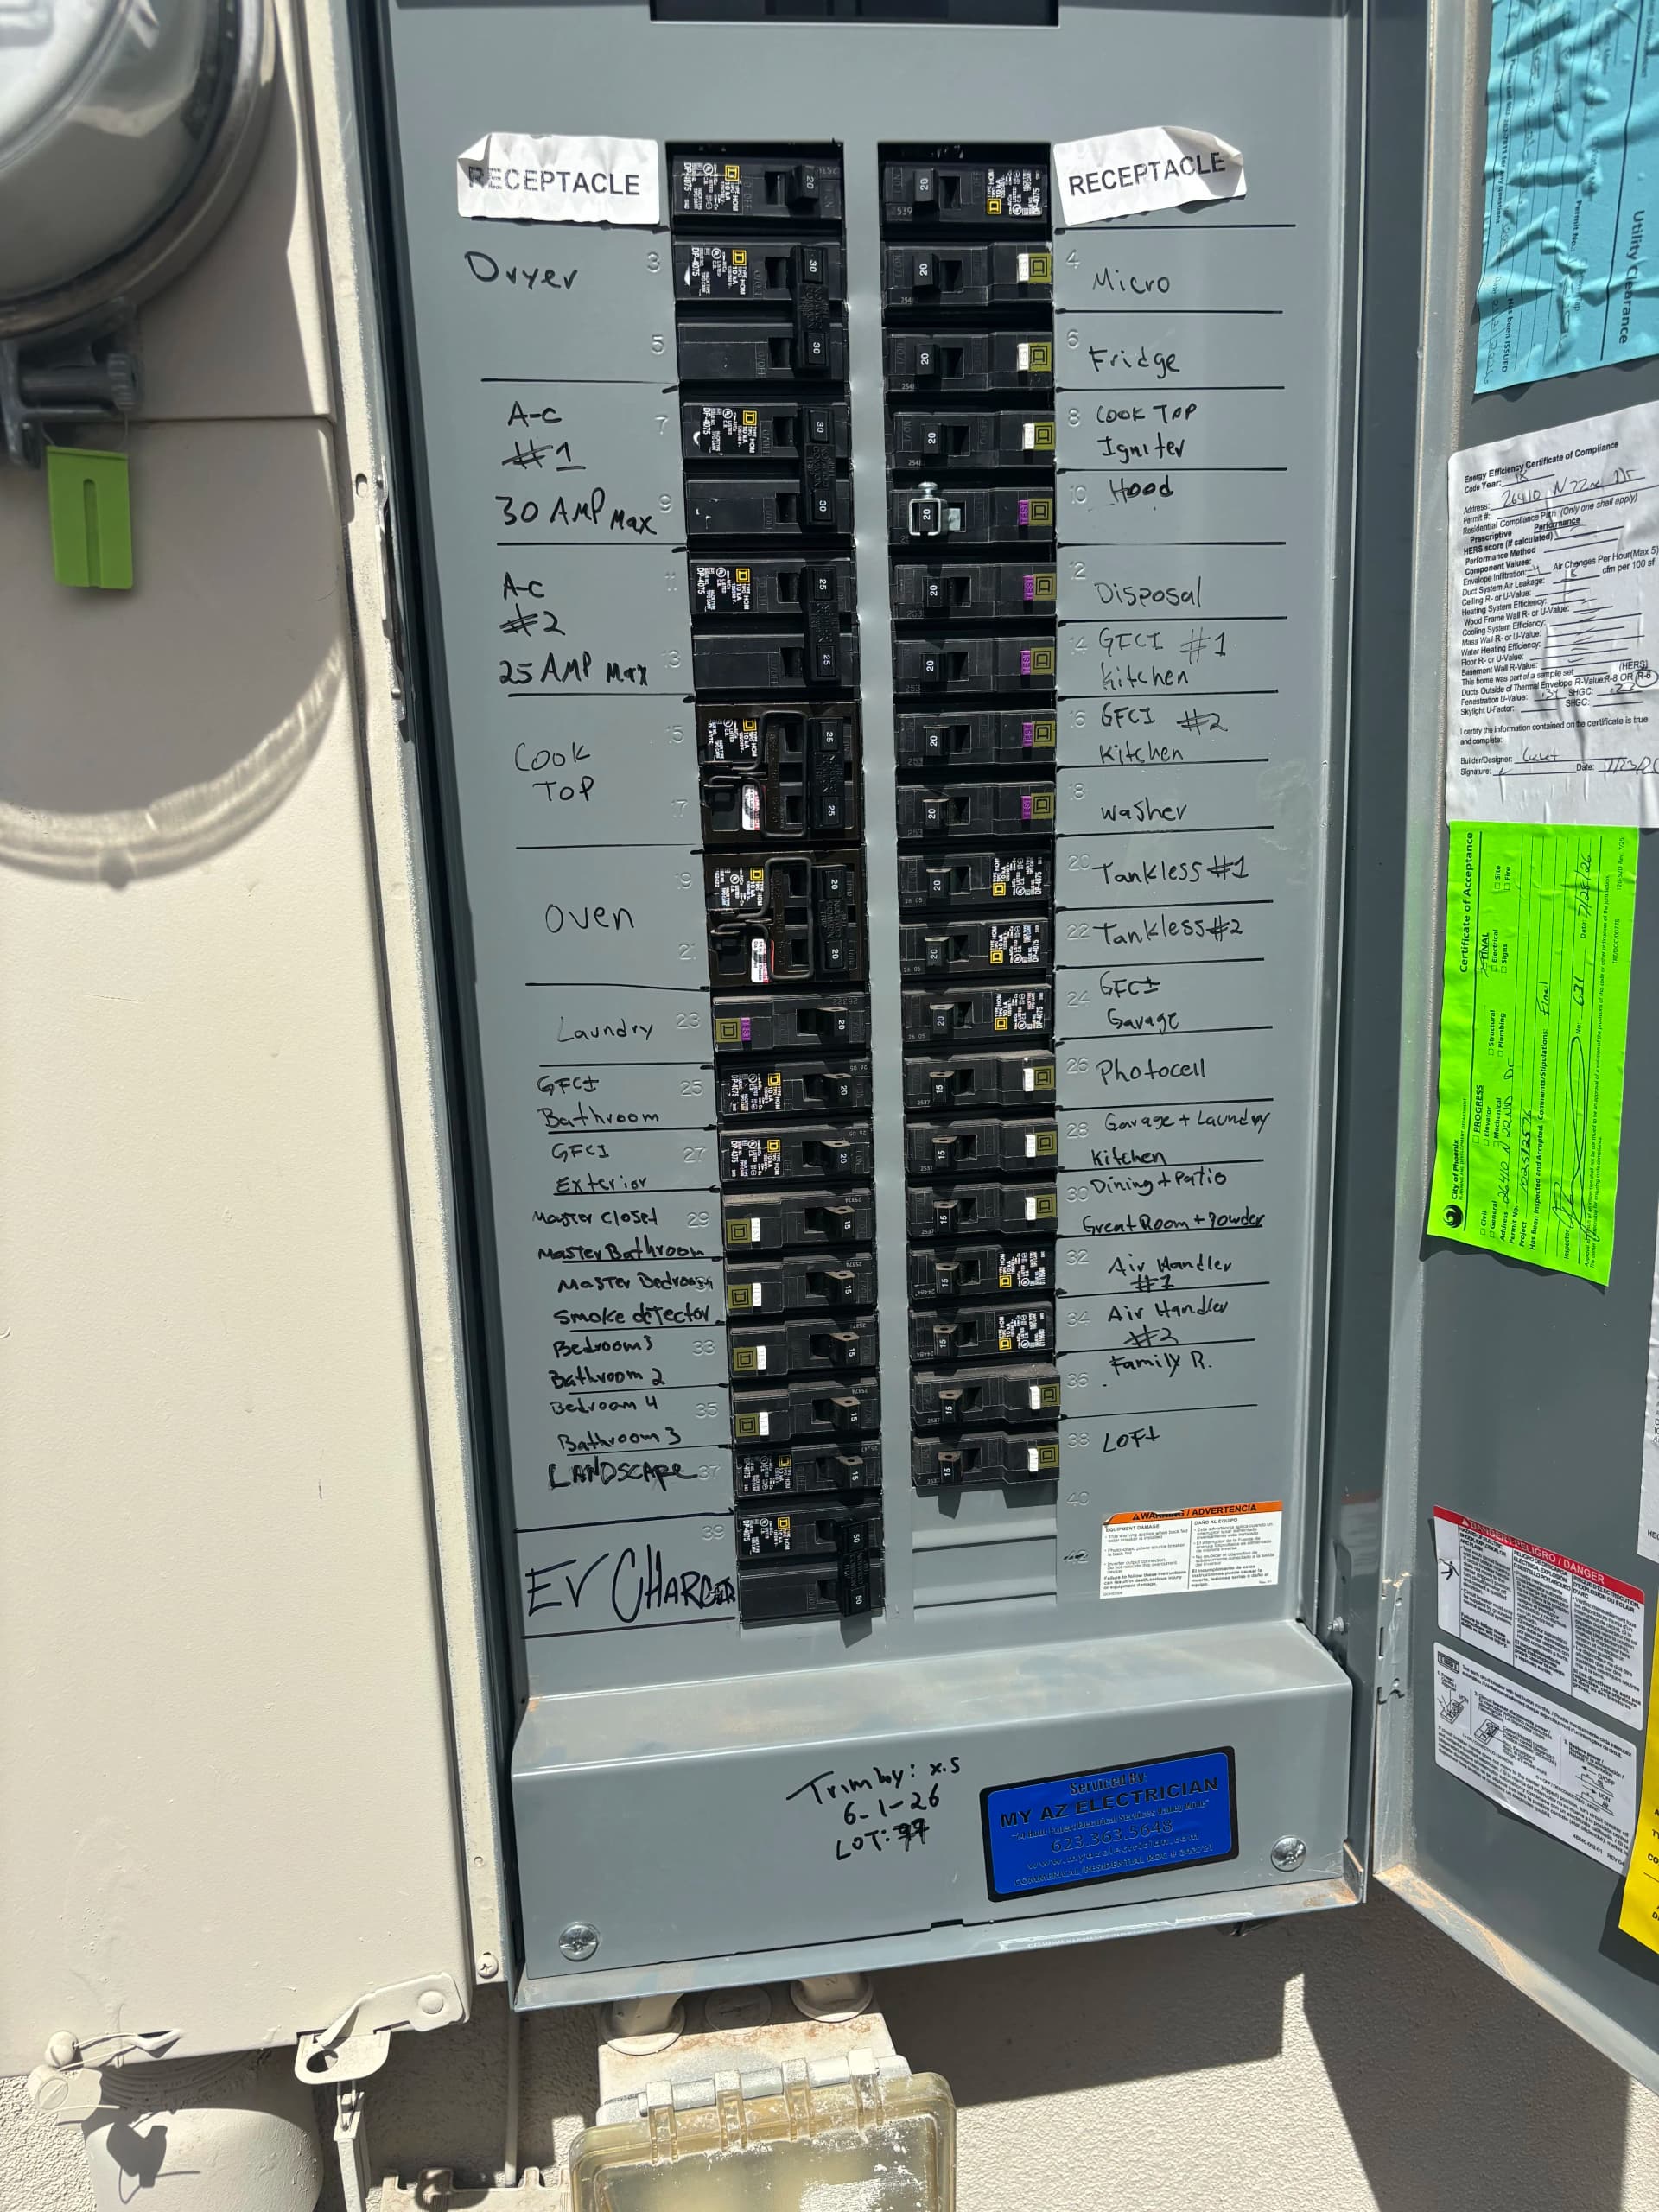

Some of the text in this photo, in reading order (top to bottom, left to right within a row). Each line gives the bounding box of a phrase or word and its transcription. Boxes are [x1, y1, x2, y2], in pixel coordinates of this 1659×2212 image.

[467, 166, 639, 196] RECEPTACLE
[806, 175, 815, 190] 20
[919, 177, 928, 192] 20
[1068, 150, 1226, 196] RECEPTACLE
[464, 250, 579, 290] Dryer
[809, 259, 817, 273] 30
[919, 263, 928, 277] 20
[1618, 209, 1646, 345] Utility Clearance
[1091, 269, 1171, 294] Micro
[1088, 346, 1181, 374] Fridge
[1500, 342, 1510, 372] ISSUED
[501, 435, 587, 471] #1
[1097, 432, 1187, 464] Igniter
[1465, 473, 1487, 483] Energy
[1489, 463, 1524, 478] Efficiency
[1526, 454, 1564, 469] Certificate
[1575, 441, 1618, 458] Compliance
[1109, 474, 1174, 505] Hood
[1465, 480, 1501, 493] Code Year:
[494, 495, 540, 526] 30
[1020, 499, 1029, 525] TEST
[1464, 504, 1491, 514] Address:
[1534, 517, 1580, 531] Performance
[819, 578, 827, 590] 25
[1094, 575, 1202, 607] Disposal
[499, 602, 566, 637] #2
[1098, 626, 1227, 664] GFCI #1
[498, 661, 533, 685] 25
[1100, 702, 1229, 734] GFCI #2
[1092, 855, 1249, 885] Tankless #1
[1459, 832, 1473, 973] Certificate of Acceptance
[544, 904, 635, 933] Oven
[1092, 914, 1243, 945] Tankless #2
[1099, 971, 1161, 997] GFCI
[556, 1016, 654, 1042] Laundry
[1107, 1009, 1180, 1035] Garage
[1096, 1058, 1206, 1085] Photocell
[536, 1076, 600, 1096] GFCI
[935, 1082, 944, 1095] 15
[537, 1101, 660, 1129] Bathroom
[1104, 1113, 1176, 1133] Garage
[1196, 1106, 1271, 1135] Laundry
[1473, 1084, 1482, 1133] PROGRESS
[1493, 1097, 1502, 1139] Mechanical
[551, 1142, 610, 1163] GFCI
[555, 1173, 648, 1194] Exterior
[1090, 1176, 1154, 1196] Dining
[1452, 1173, 1459, 1182] of
[532, 1209, 593, 1227] Master
[1083, 1214, 1136, 1236] Great
[1140, 1214, 1189, 1230] Room
[1500, 1211, 1509, 1242] Address
[538, 1234, 705, 1261] Master Bathroom
[1108, 1253, 1232, 1276] Air Handler
[557, 1276, 631, 1293] Master
[1107, 1295, 1229, 1323] Air Handler
[1122, 1326, 1181, 1349] #2
[548, 1366, 665, 1389] Bathroom 2
[1109, 1351, 1181, 1378] Family
[550, 1395, 658, 1415] Bedroom 4
[557, 1427, 682, 1452] Bathroom 3
[1192, 1503, 1256, 1516] ADVERTENCIA
[525, 1553, 610, 1617] EV
[1563, 1560, 1605, 1585] DANGER
[1070, 1772, 1148, 1796] Serviced By:
[1001, 1809, 1032, 1828] MY
[1039, 1804, 1069, 1821] AZ
[1076, 1777, 1218, 1815] ELECTRICIAN
[1051, 1819, 1173, 1853] 623.363.5648
